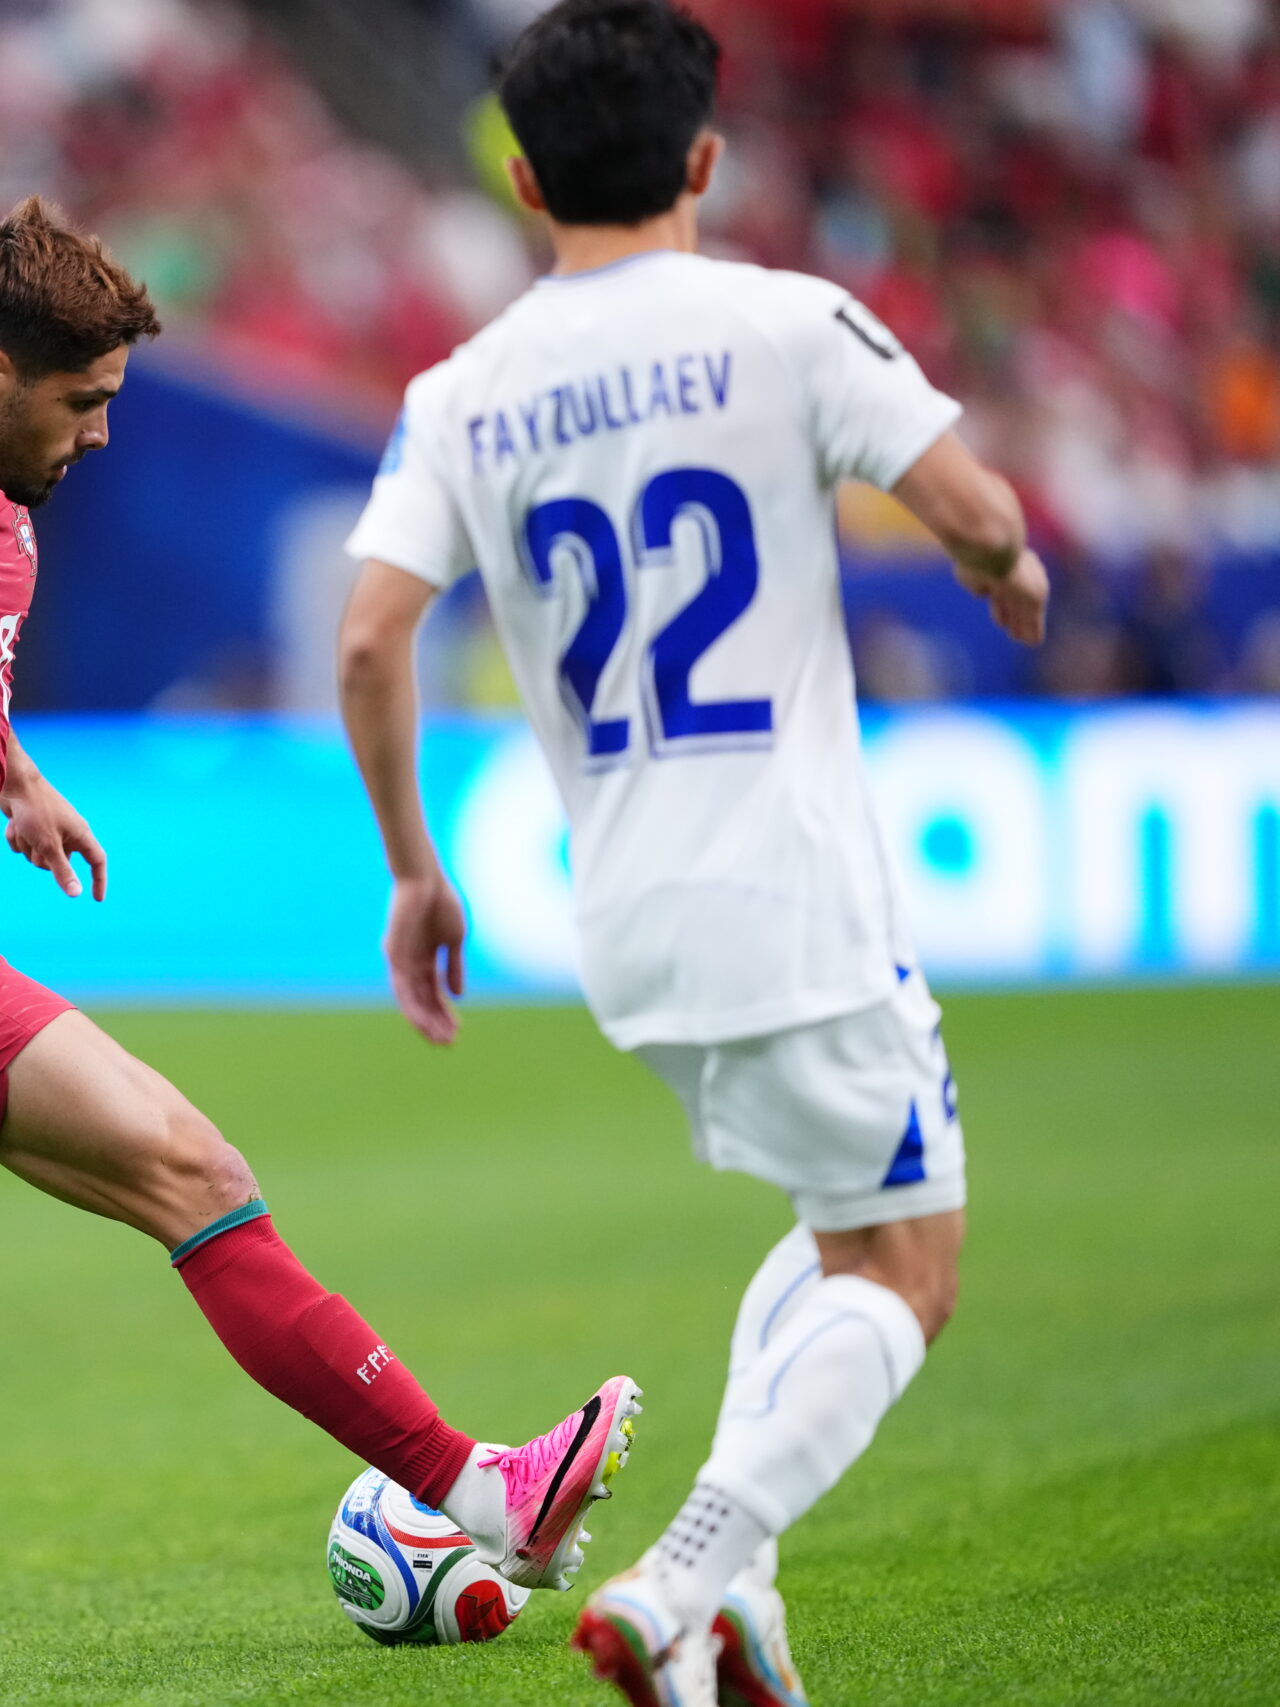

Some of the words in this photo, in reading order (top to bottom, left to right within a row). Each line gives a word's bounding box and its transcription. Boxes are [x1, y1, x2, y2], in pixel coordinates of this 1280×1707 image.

[468, 352, 730, 474] FAYZULLAEV
[522, 467, 776, 773] 22
[331, 1550, 372, 1583] TRIONDA
